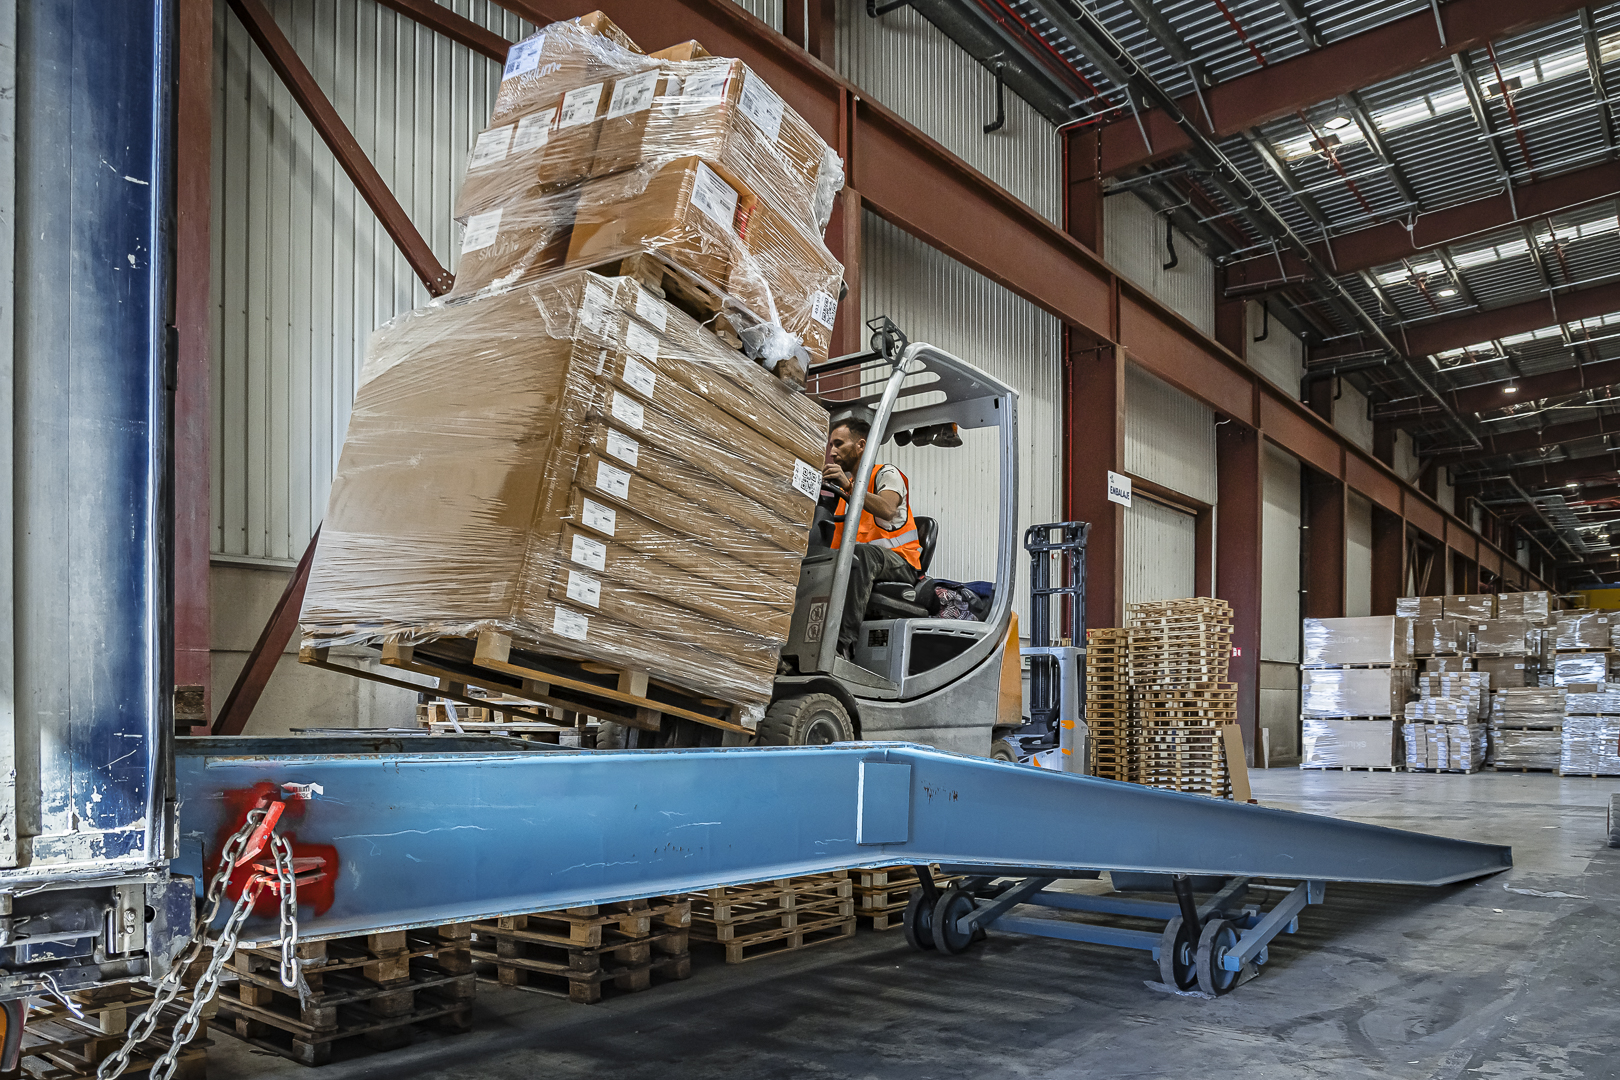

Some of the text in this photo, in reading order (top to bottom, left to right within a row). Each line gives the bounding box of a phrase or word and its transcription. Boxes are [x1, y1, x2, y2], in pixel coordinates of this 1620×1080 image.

[520, 63, 556, 85] sklum
[478, 240, 514, 260] sklum
[1110, 486, 1130, 500] EMBALAJE
